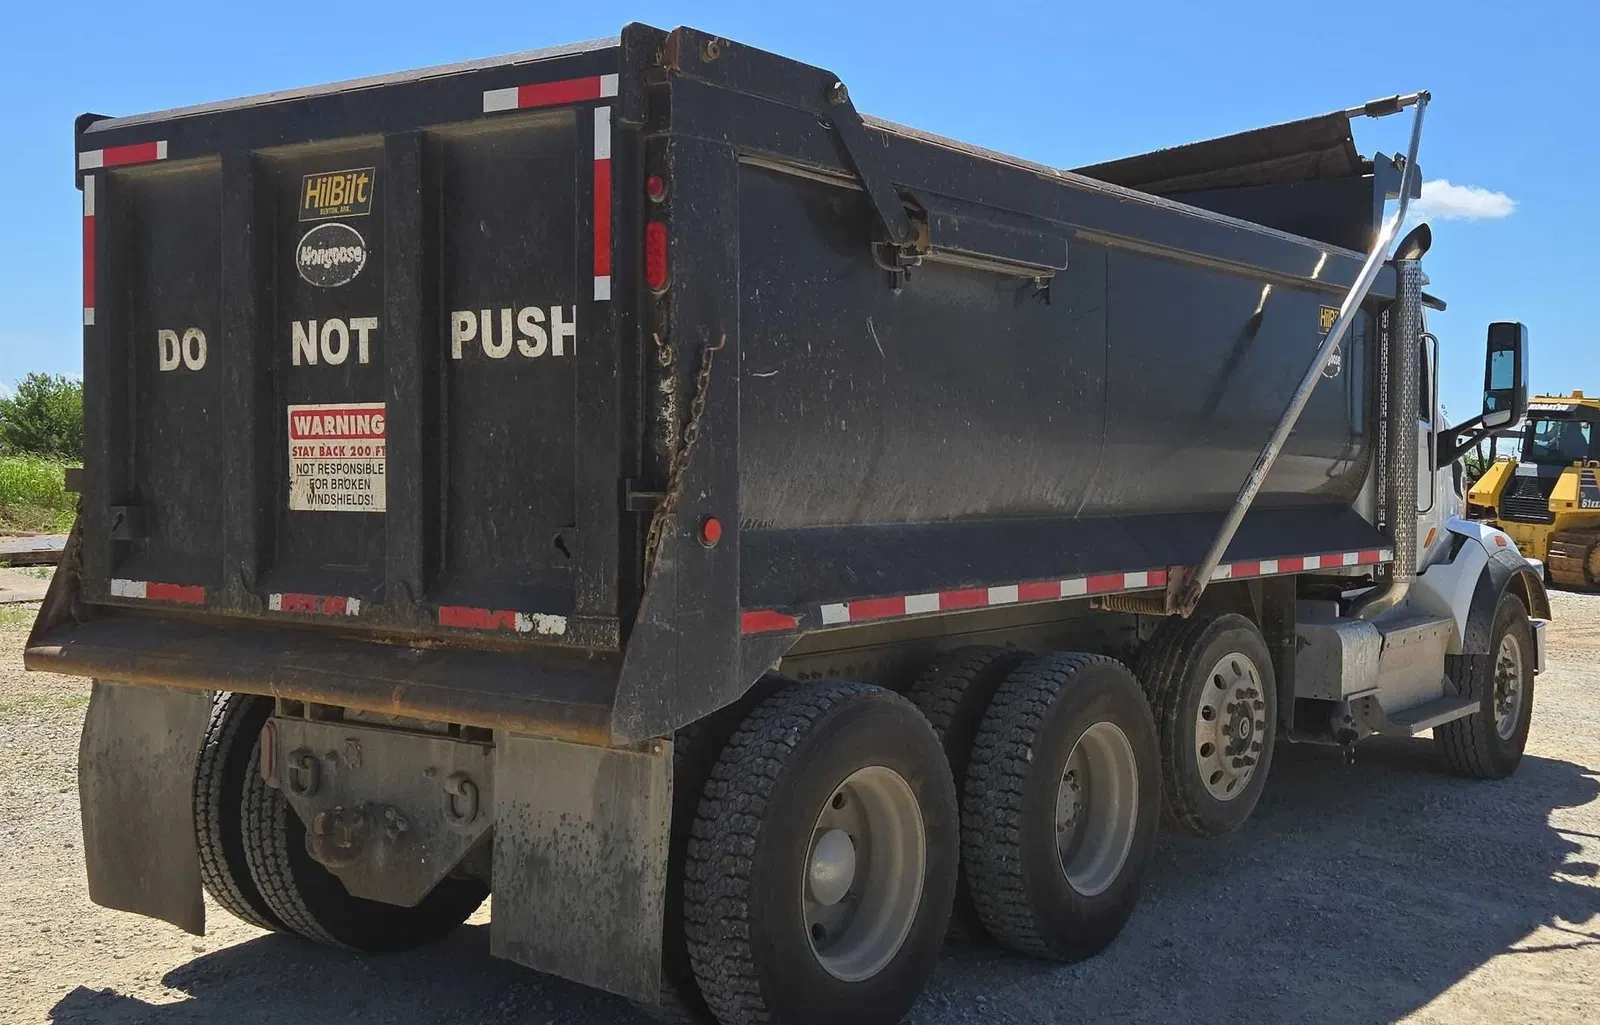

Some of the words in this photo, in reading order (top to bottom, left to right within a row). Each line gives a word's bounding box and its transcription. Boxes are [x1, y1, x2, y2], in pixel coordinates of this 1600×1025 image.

[305, 173, 370, 209] HilBilt
[300, 246, 362, 269] Mongoose
[158, 327, 208, 372] DO
[291, 316, 379, 367] NOT
[451, 304, 577, 360] PUSH
[293, 414, 386, 436] WARNING
[292, 446, 316, 457] STAY
[319, 446, 346, 457] BACK
[350, 445, 372, 457] 200
[296, 463, 315, 475] NOT
[318, 463, 385, 475] RESPONSIBLE
[309, 479, 329, 490] FOR
[331, 479, 371, 490] BROKEN
[306, 493, 375, 506] WINDSHIELDS!
